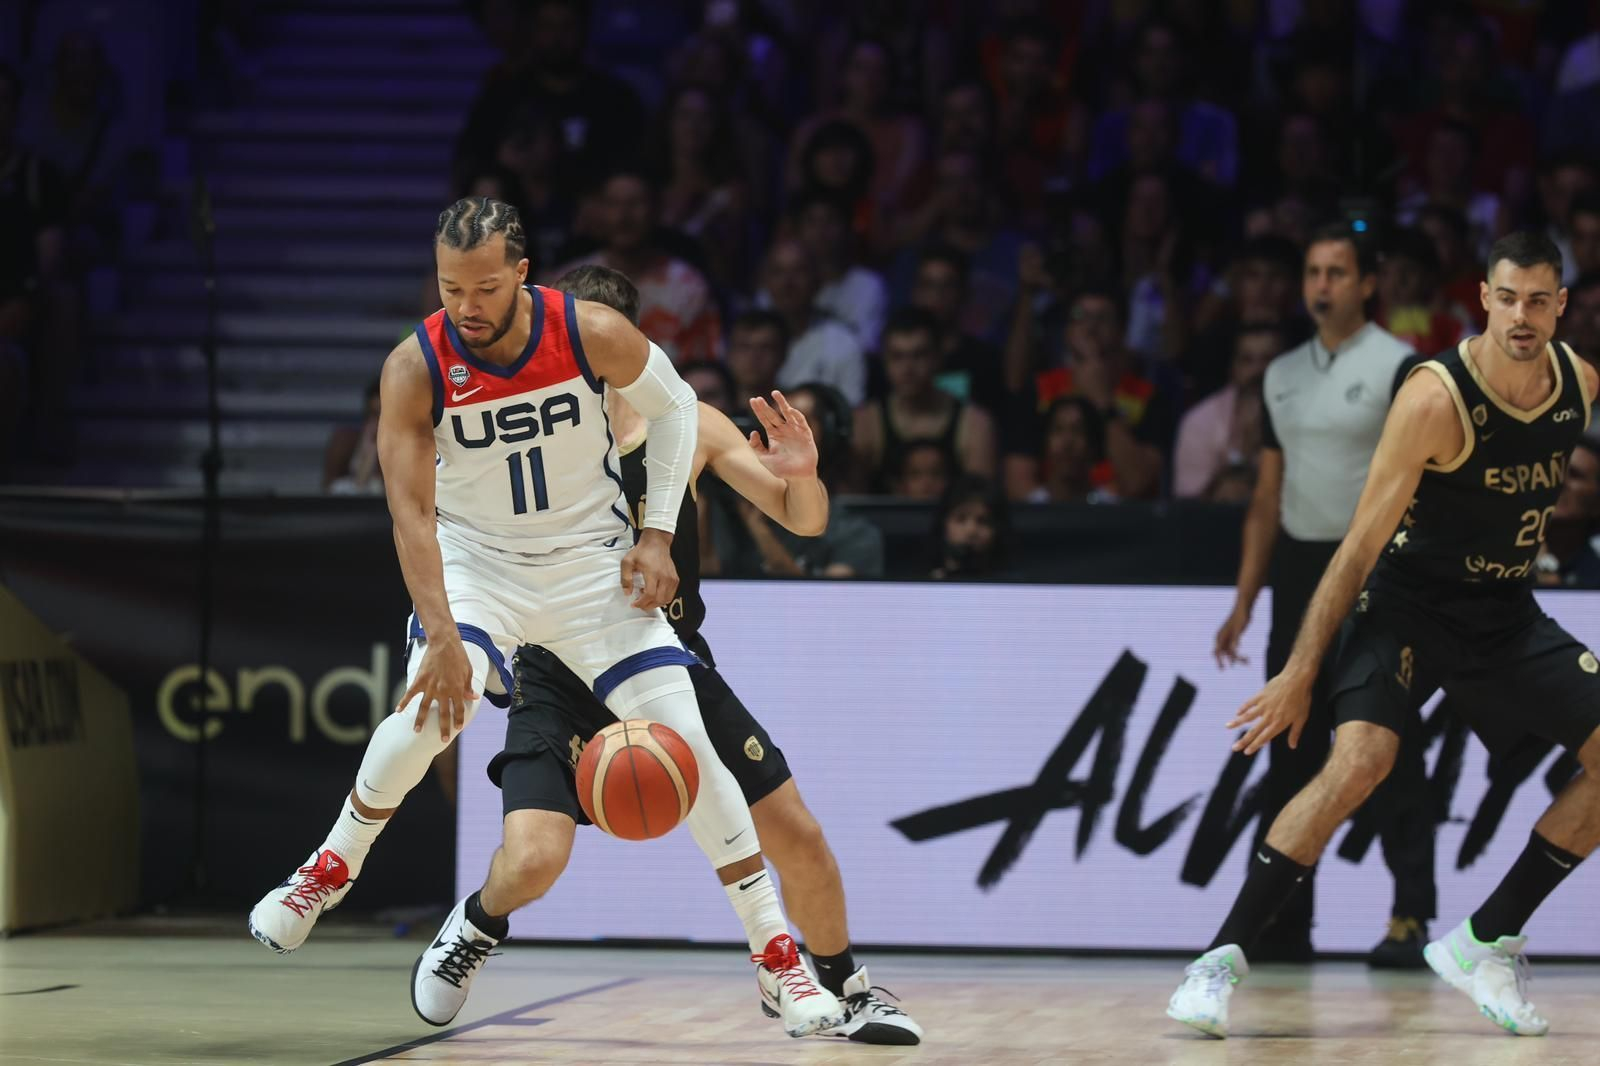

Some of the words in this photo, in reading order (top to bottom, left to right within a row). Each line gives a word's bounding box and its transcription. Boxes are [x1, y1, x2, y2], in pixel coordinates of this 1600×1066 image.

[451, 392, 580, 449] USA
[505, 446, 549, 515] 11
[156, 642, 406, 745] end
